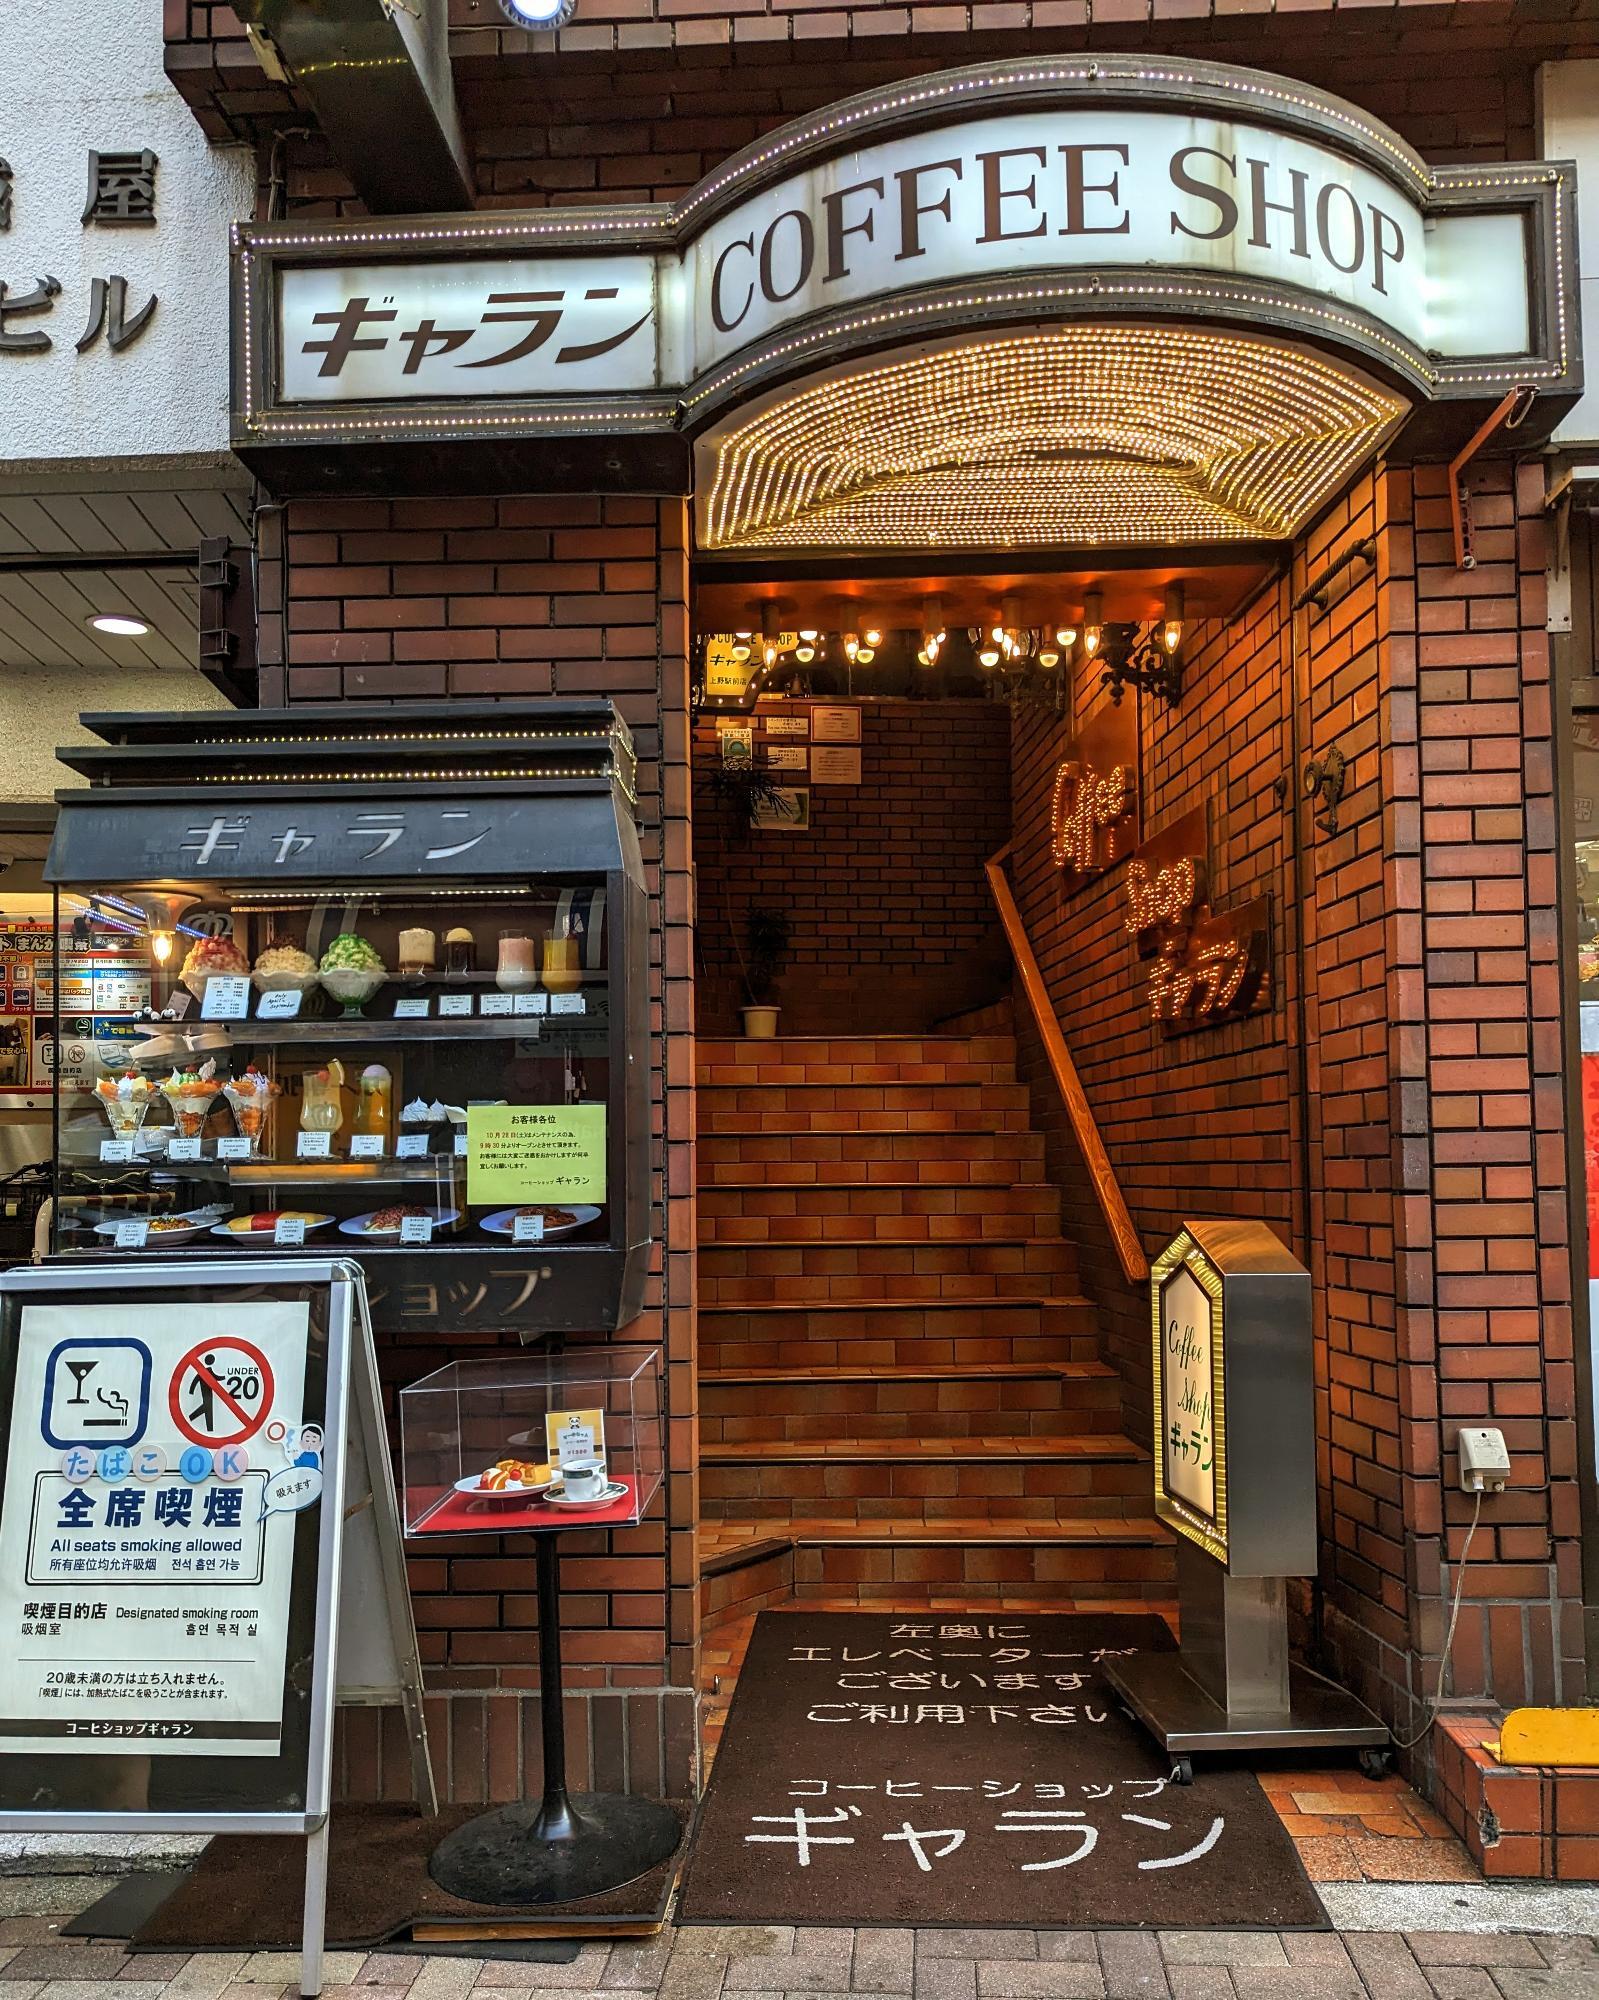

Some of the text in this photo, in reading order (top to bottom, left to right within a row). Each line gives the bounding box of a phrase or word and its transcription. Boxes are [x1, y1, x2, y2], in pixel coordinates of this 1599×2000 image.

[0, 148, 159, 230] 屋
[711, 143, 1406, 332] COFFEE SHOP
[0, 273, 159, 352] ビル
[301, 287, 655, 378] ギャラン
[180, 810, 493, 864] ギャラン
[511, 1115, 557, 1125] お客様各位
[555, 1176, 591, 1185] ギャラン
[1168, 1319, 1205, 1370] Coffee
[227, 1367, 260, 1376] UNDER
[226, 1376, 260, 1400] 20
[1170, 1420, 1213, 1471] ギャラン
[66, 1450, 241, 1477] たばこ OK
[275, 1478, 312, 1498] 吸えます
[57, 1487, 244, 1528] 全席喫煙
[50, 1538, 242, 1554] All seats smoking allowed
[49, 1558, 157, 1571] 所有座位均允许吸烟
[171, 1558, 192, 1571] 전석
[219, 1558, 241, 1571] 가능
[24, 1602, 108, 1620] 喫煙目的店
[116, 1606, 259, 1621] Designated smoking room
[21, 1622, 62, 1636] 吸烟室
[889, 1624, 1032, 1640] 左奥に
[787, 1646, 1139, 1664] エレベーターが
[46, 1671, 225, 1686] 20歳未満の方は立ち入れません。
[837, 1670, 1092, 1691] ございます
[806, 1702, 1136, 1725] ご利用下さい
[65, 1722, 194, 1736] コーヒショップギャラン
[788, 1778, 1170, 1799] コーヒーショップ
[744, 1804, 1225, 1873] ギャラン
